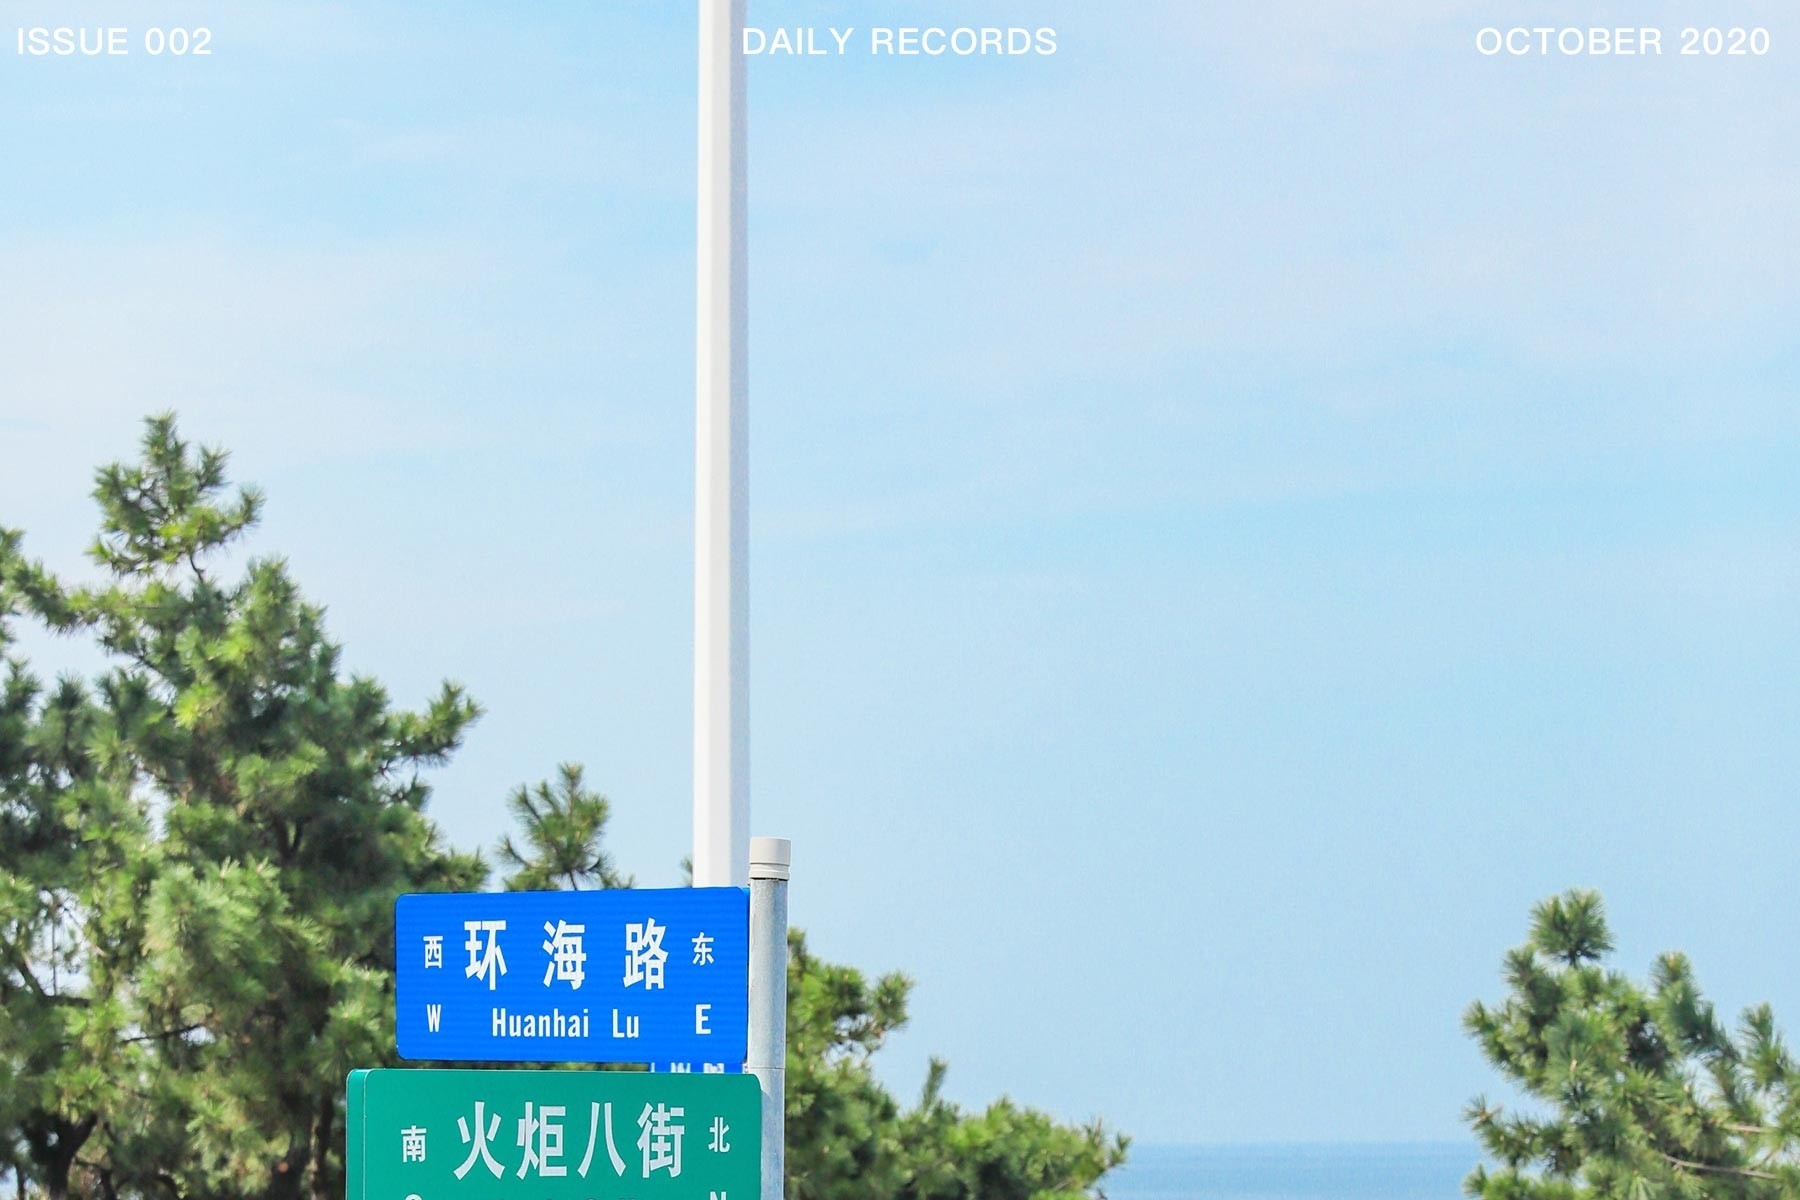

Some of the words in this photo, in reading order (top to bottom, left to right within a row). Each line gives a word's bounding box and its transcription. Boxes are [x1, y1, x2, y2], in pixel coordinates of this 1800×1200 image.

[423, 935, 443, 968] 西
[464, 917, 669, 990] 环海路
[691, 932, 715, 966] 东
[427, 1004, 441, 1033] W
[492, 1008, 589, 1037] Huanhai
[612, 1009, 639, 1038] Lu
[695, 1004, 711, 1035] E
[401, 1125, 427, 1163] 南
[453, 1101, 685, 1180] 火炬八街
[708, 1117, 730, 1153] 北
